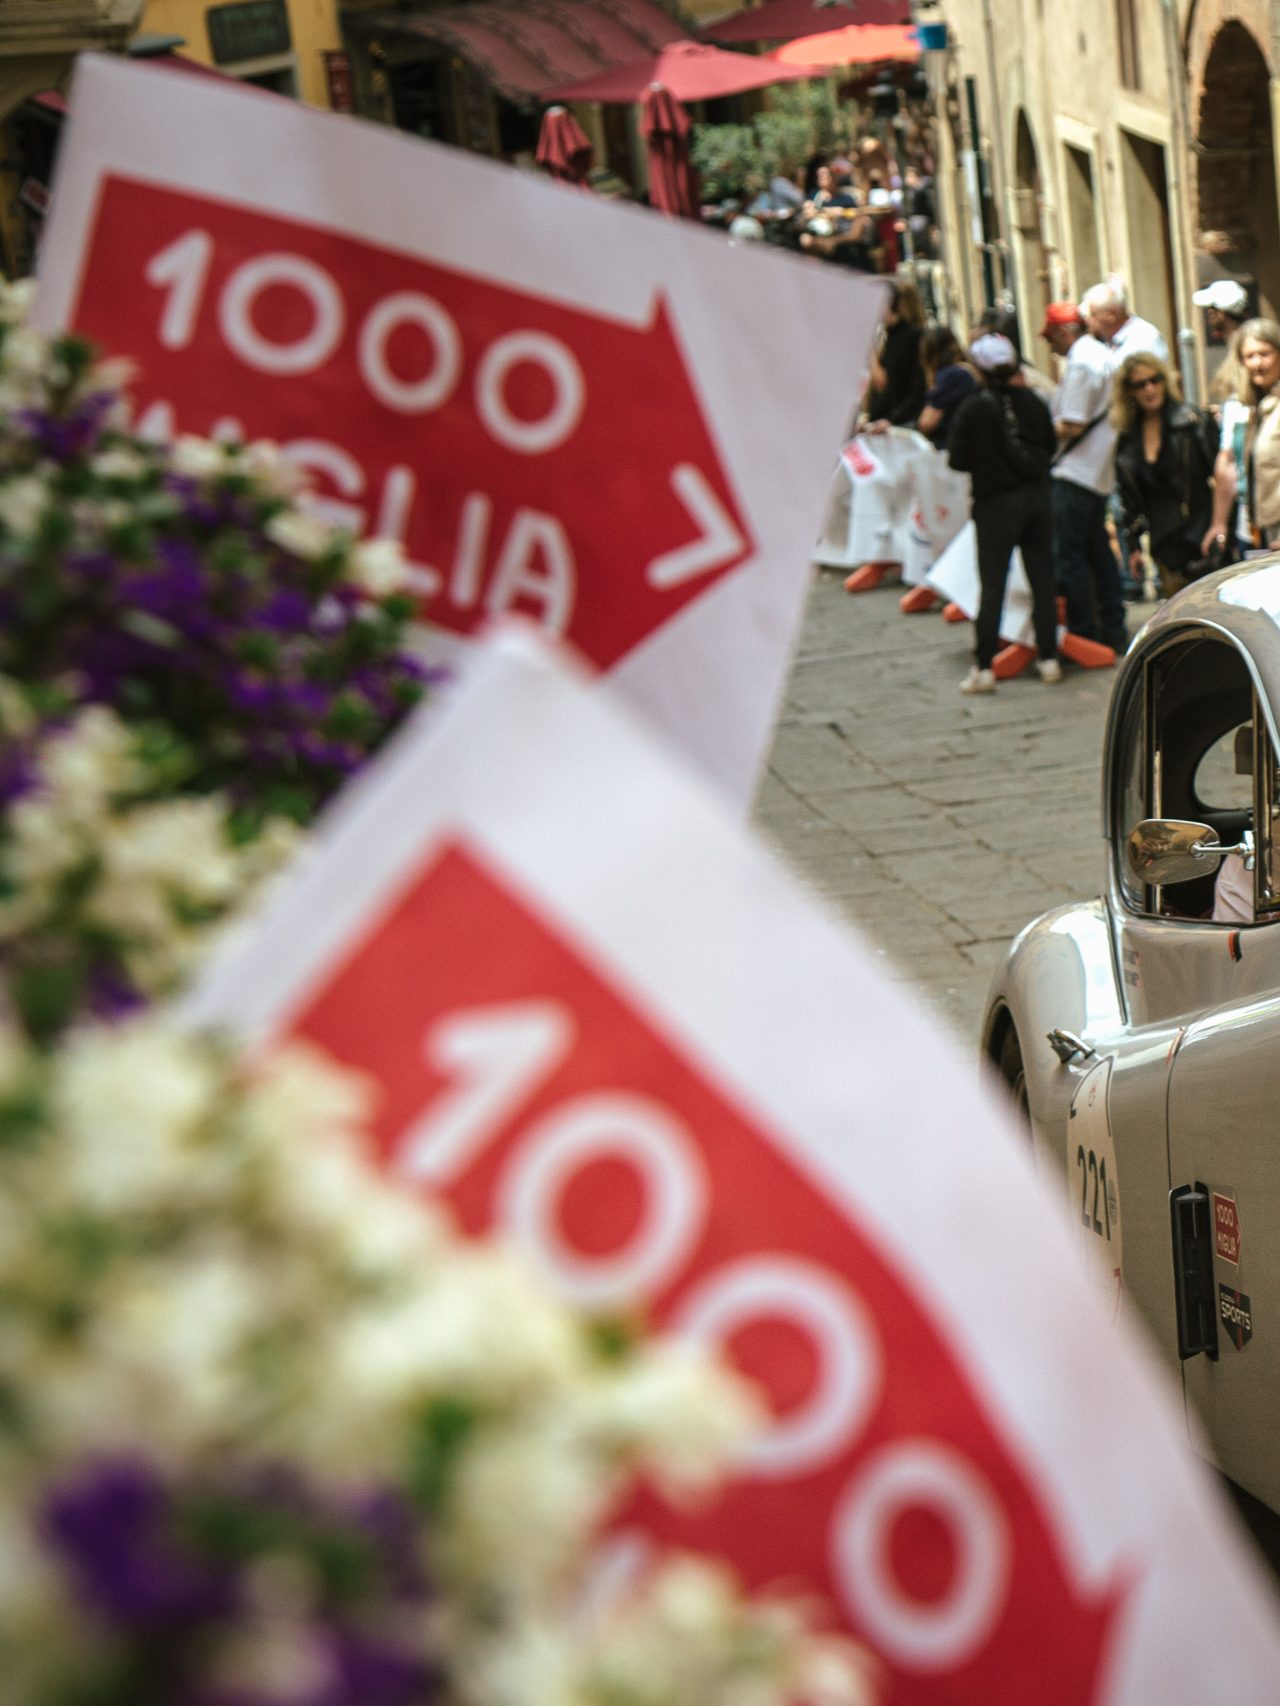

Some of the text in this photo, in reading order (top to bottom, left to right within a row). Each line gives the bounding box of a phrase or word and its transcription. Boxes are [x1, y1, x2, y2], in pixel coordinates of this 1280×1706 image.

[145, 228, 584, 455] 1000
[1078, 1145, 1111, 1241] 221
[1216, 1203, 1234, 1228] 1000
[404, 1000, 1013, 1677] 1000
[1221, 1301, 1251, 1331] SPORTS
